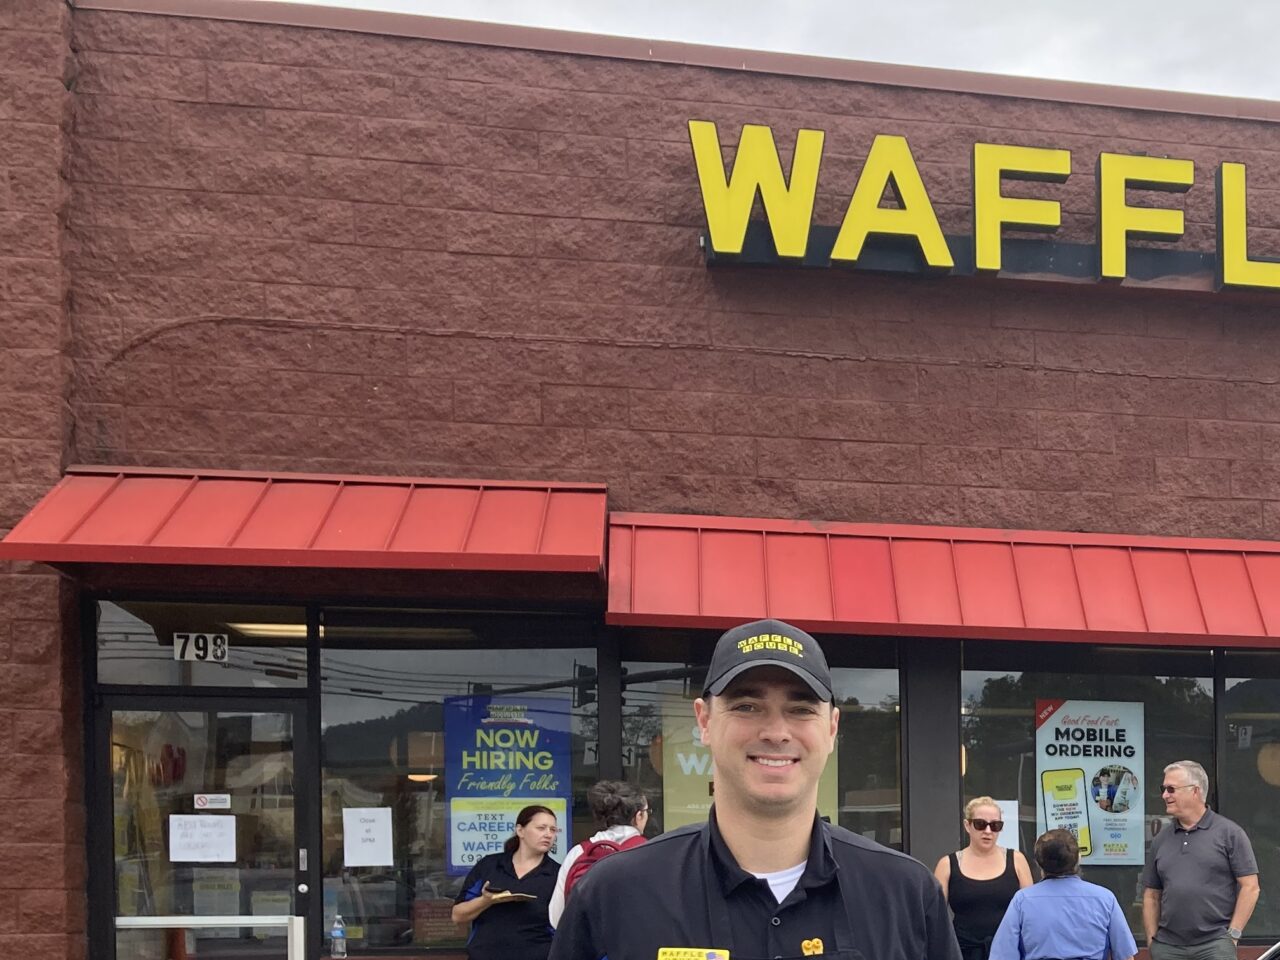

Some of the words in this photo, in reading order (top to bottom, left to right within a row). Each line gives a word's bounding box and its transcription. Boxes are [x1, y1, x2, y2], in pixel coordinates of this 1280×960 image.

[176, 634, 227, 661] 798
[738, 633, 803, 650] WAFFLE
[1039, 704, 1054, 720] NEW
[1061, 714, 1081, 726] Good
[1080, 714, 1101, 726] Food
[476, 728, 540, 748] NOW
[1055, 727, 1126, 742] MOBILE
[1045, 743, 1136, 758] ORDERING
[462, 750, 554, 770] HIRING
[457, 772, 516, 797] Friendly
[519, 772, 559, 791] Folks
[476, 813, 505, 821] TEXT
[457, 822, 515, 832] CAREER
[462, 841, 503, 852] WAFF
